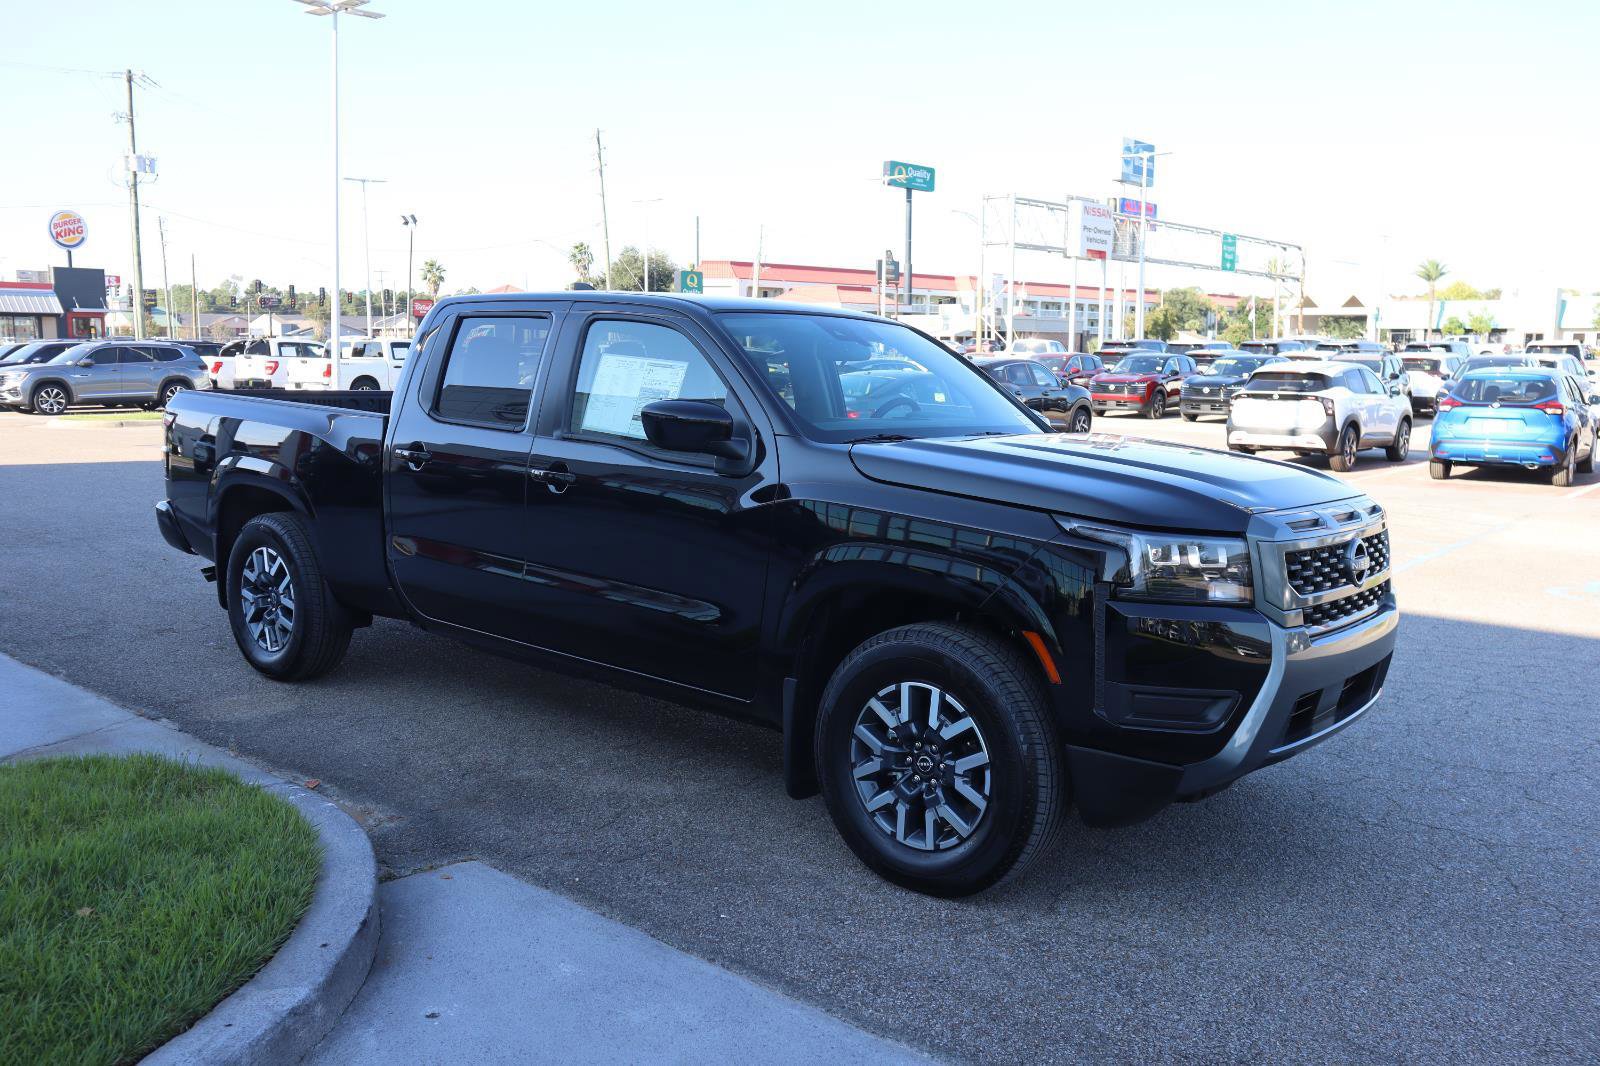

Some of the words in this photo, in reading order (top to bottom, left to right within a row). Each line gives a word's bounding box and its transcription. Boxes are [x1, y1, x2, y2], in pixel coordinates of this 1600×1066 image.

[908, 166, 931, 181] Quality
[1084, 206, 1112, 219] NISSAN
[53, 218, 82, 230] BURGER
[55, 225, 84, 239] KING
[1083, 225, 1112, 236] Pre-Owned
[1086, 236, 1108, 245] Vehicles
